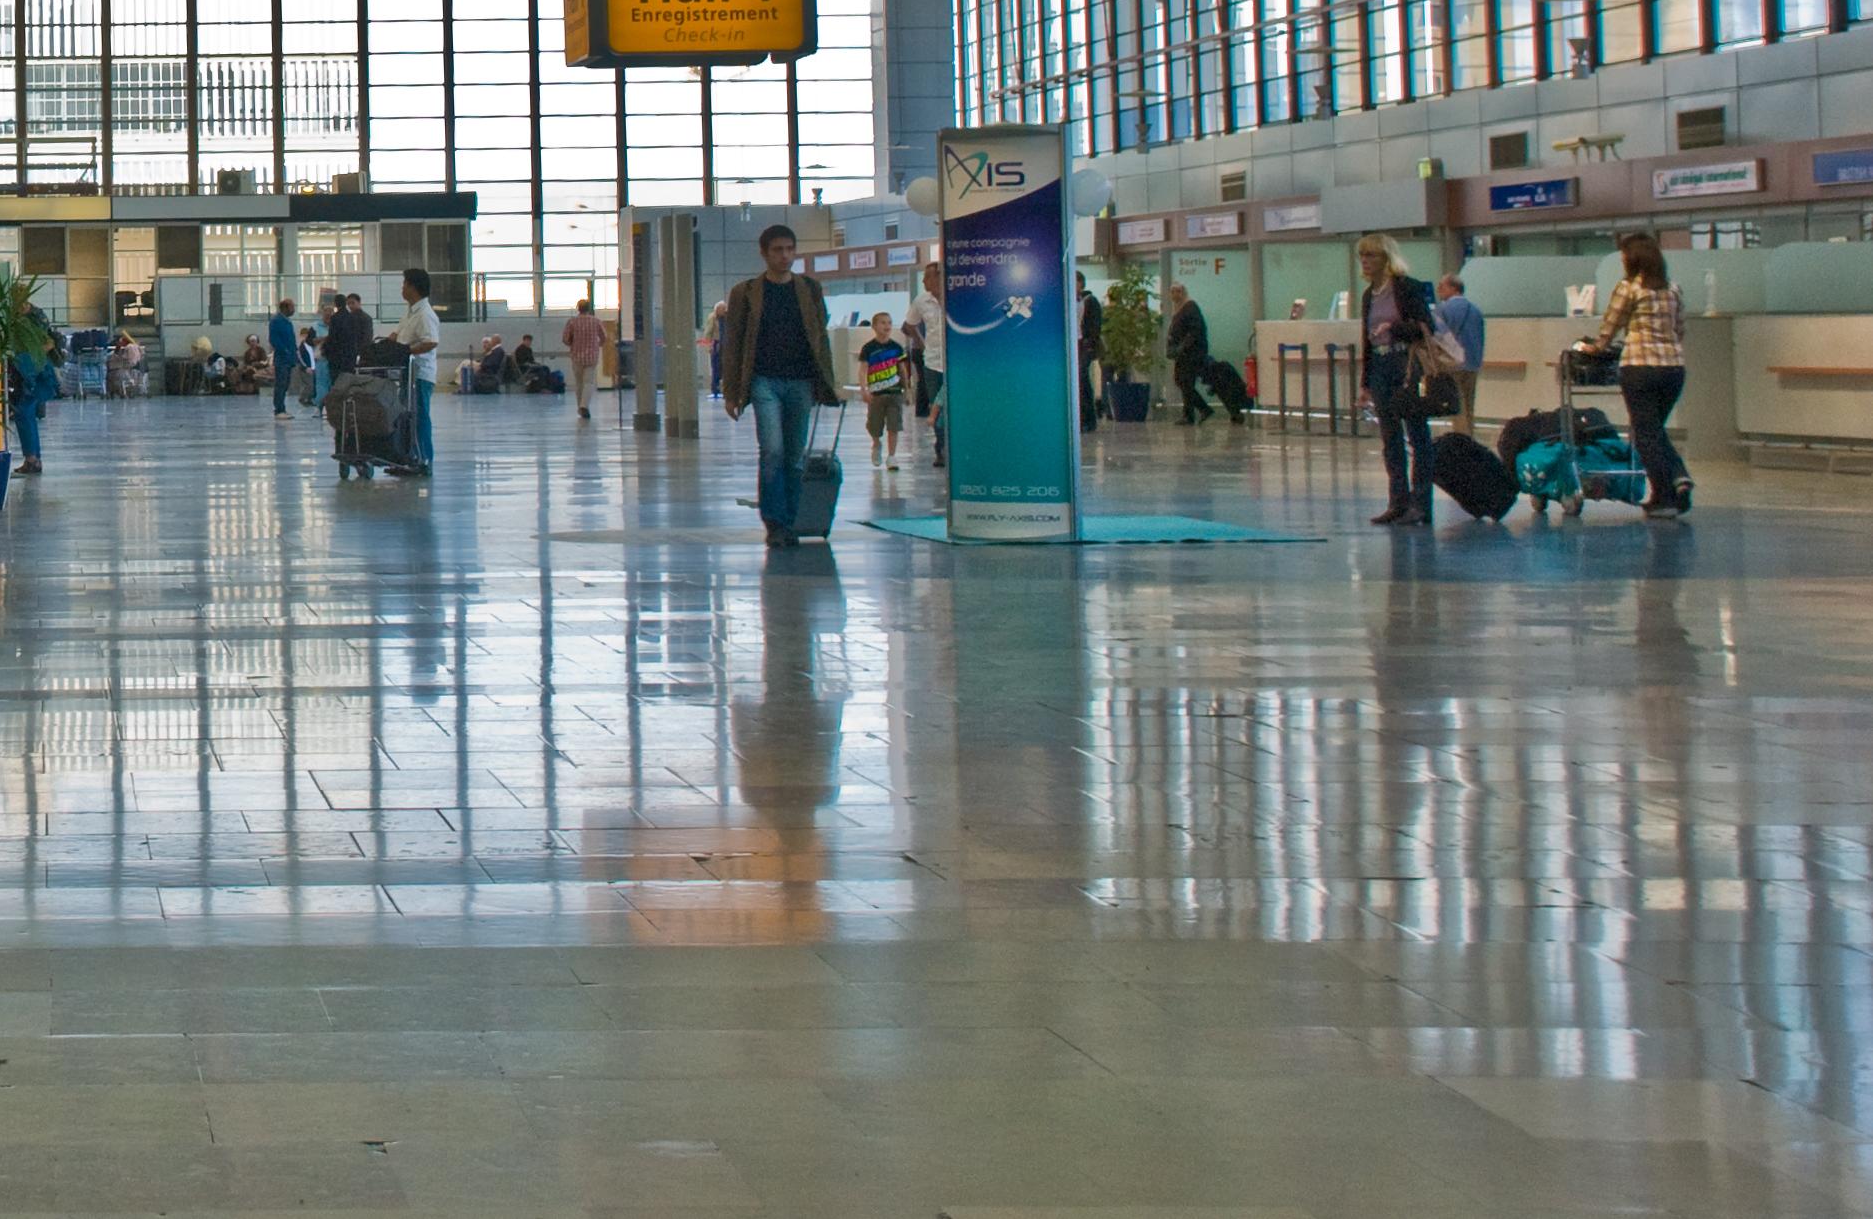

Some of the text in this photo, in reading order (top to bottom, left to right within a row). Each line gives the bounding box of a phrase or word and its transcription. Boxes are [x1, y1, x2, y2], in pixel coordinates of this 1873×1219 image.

[631, 7, 779, 25] Enregistrement
[663, 27, 745, 43] Check-in
[971, 236, 1031, 250] compagnie
[1214, 257, 1226, 275] F
